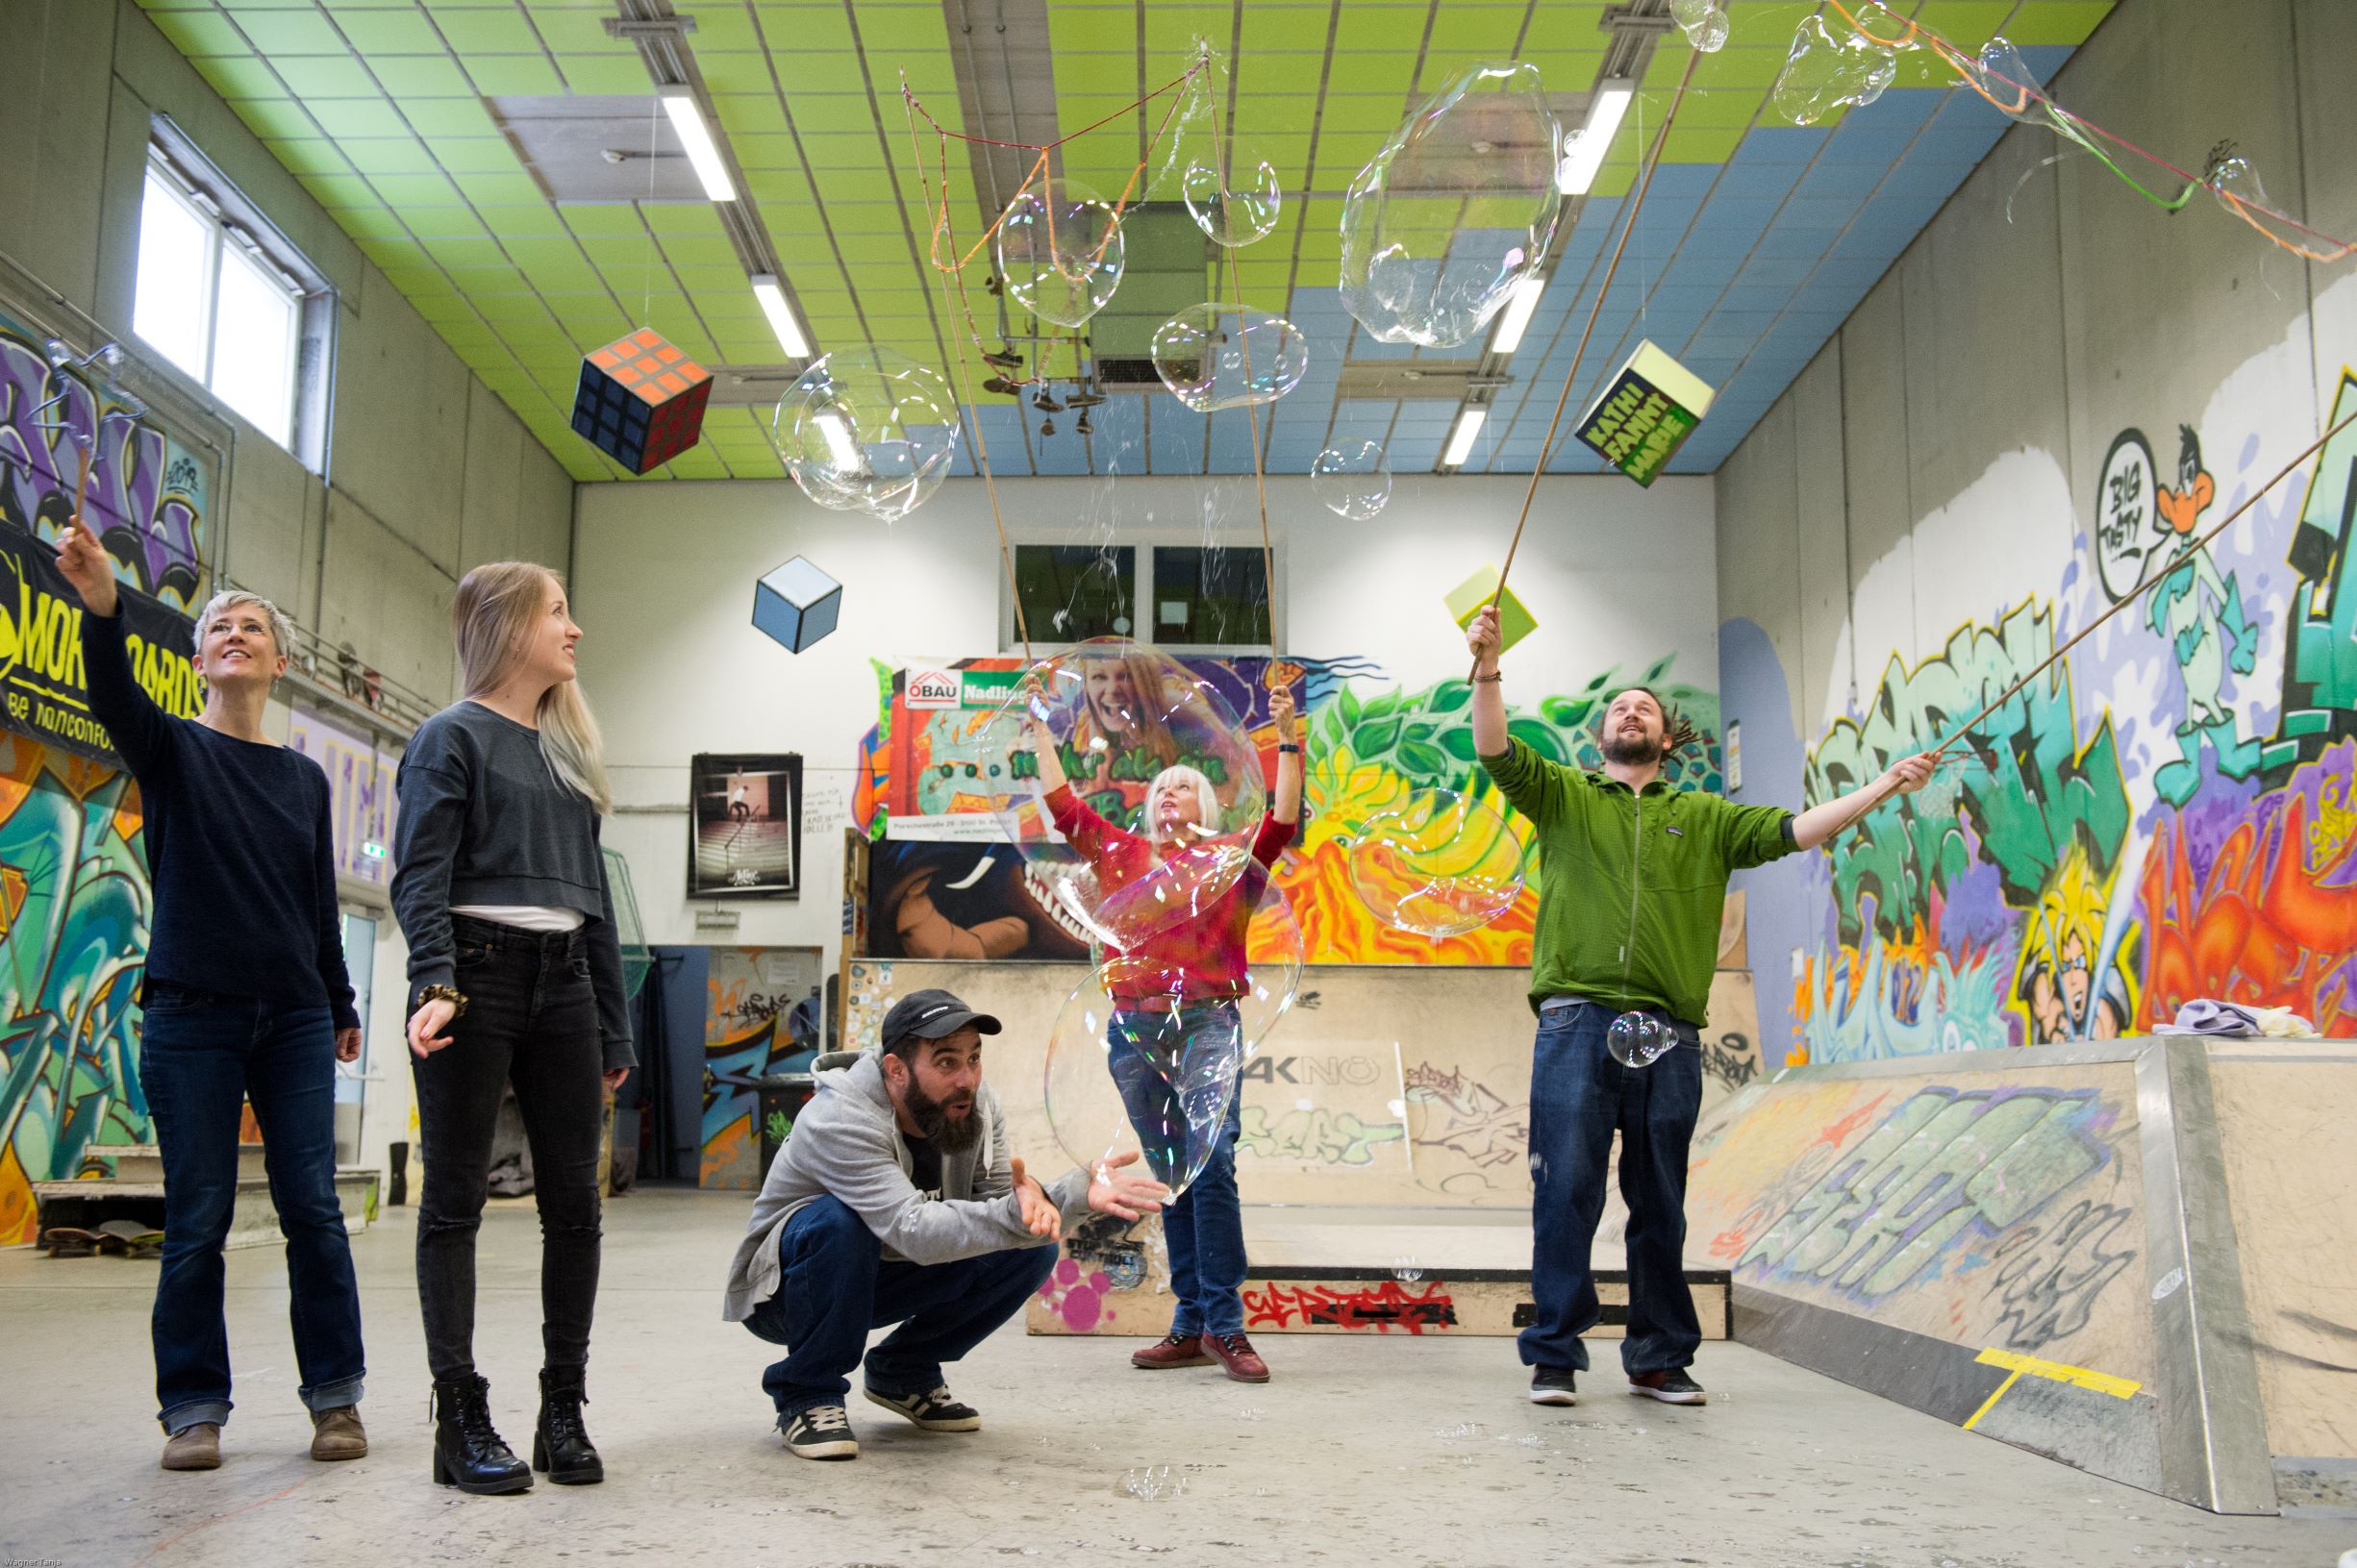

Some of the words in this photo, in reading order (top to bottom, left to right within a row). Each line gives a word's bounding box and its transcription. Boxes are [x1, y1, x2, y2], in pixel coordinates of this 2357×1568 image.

[1586, 382, 1645, 448] KATHI
[1603, 392, 1668, 462] FANNY
[2109, 460, 2142, 515] BIG
[2100, 506, 2143, 554] TASTY
